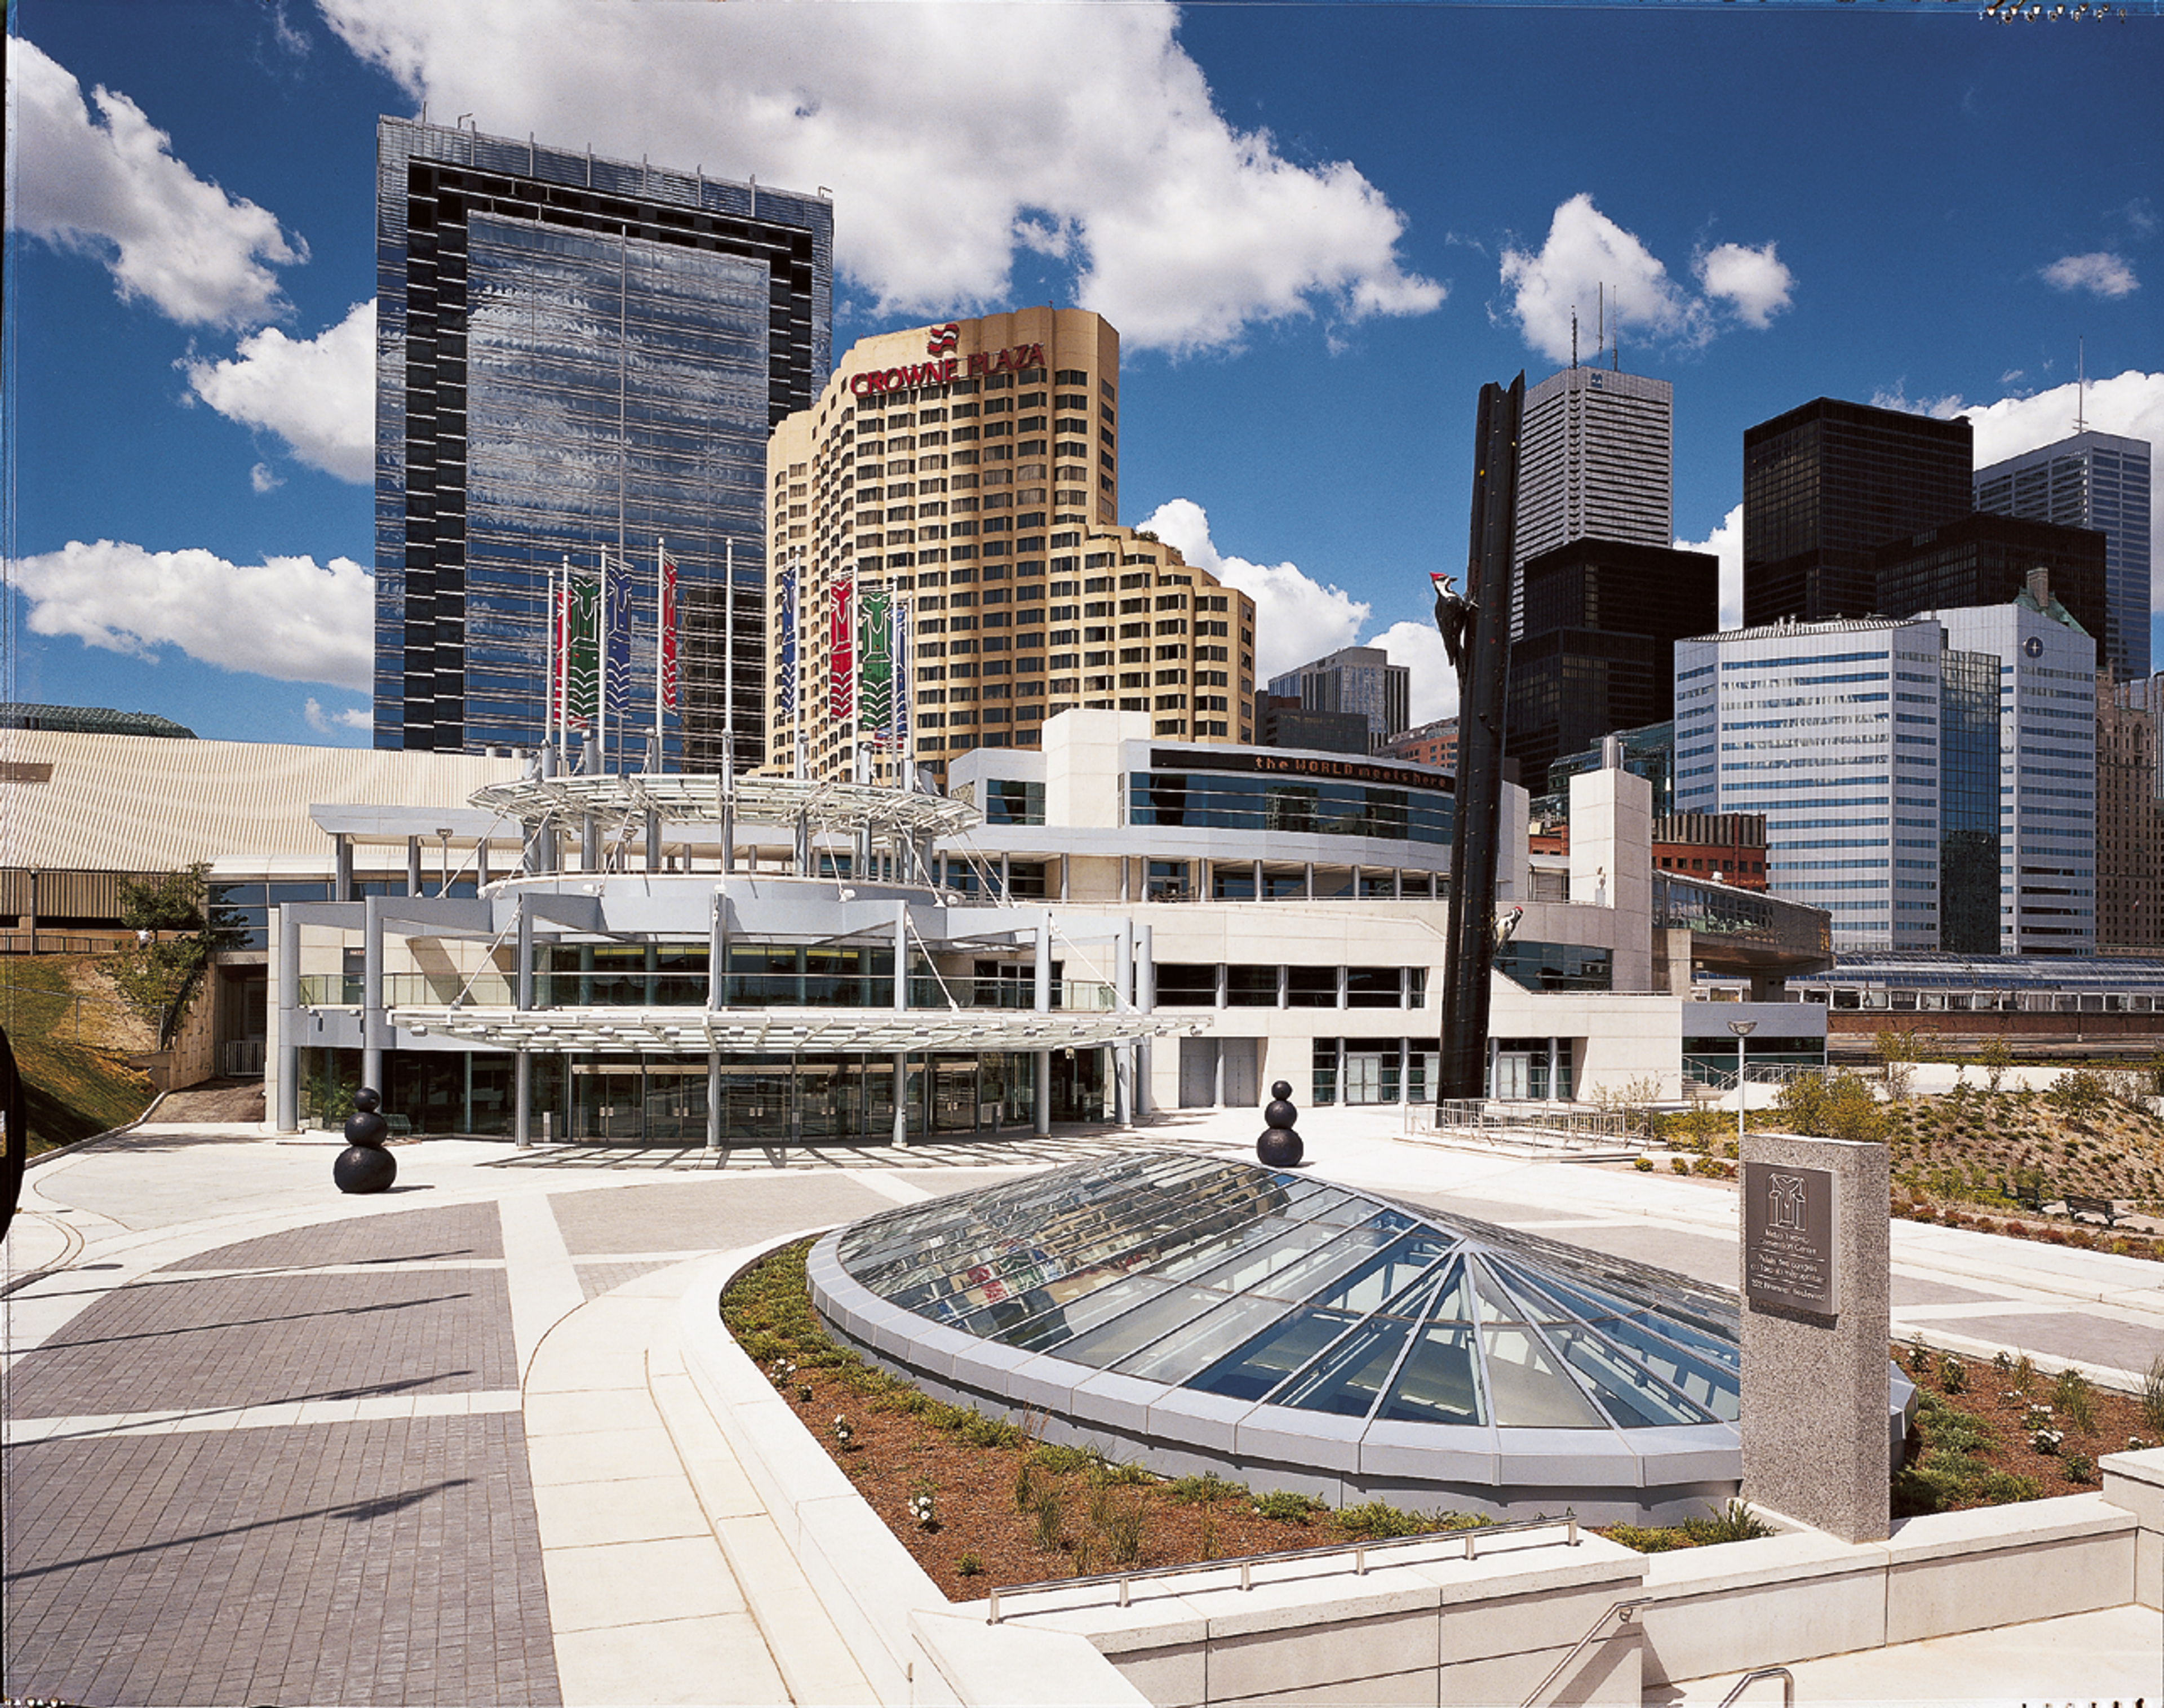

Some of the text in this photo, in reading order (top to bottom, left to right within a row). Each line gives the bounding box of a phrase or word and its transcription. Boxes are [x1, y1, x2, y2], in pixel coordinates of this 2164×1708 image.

[850, 343, 1045, 396] CROWNE PLAZA
[1256, 756, 1446, 787] the WORLD meets here
